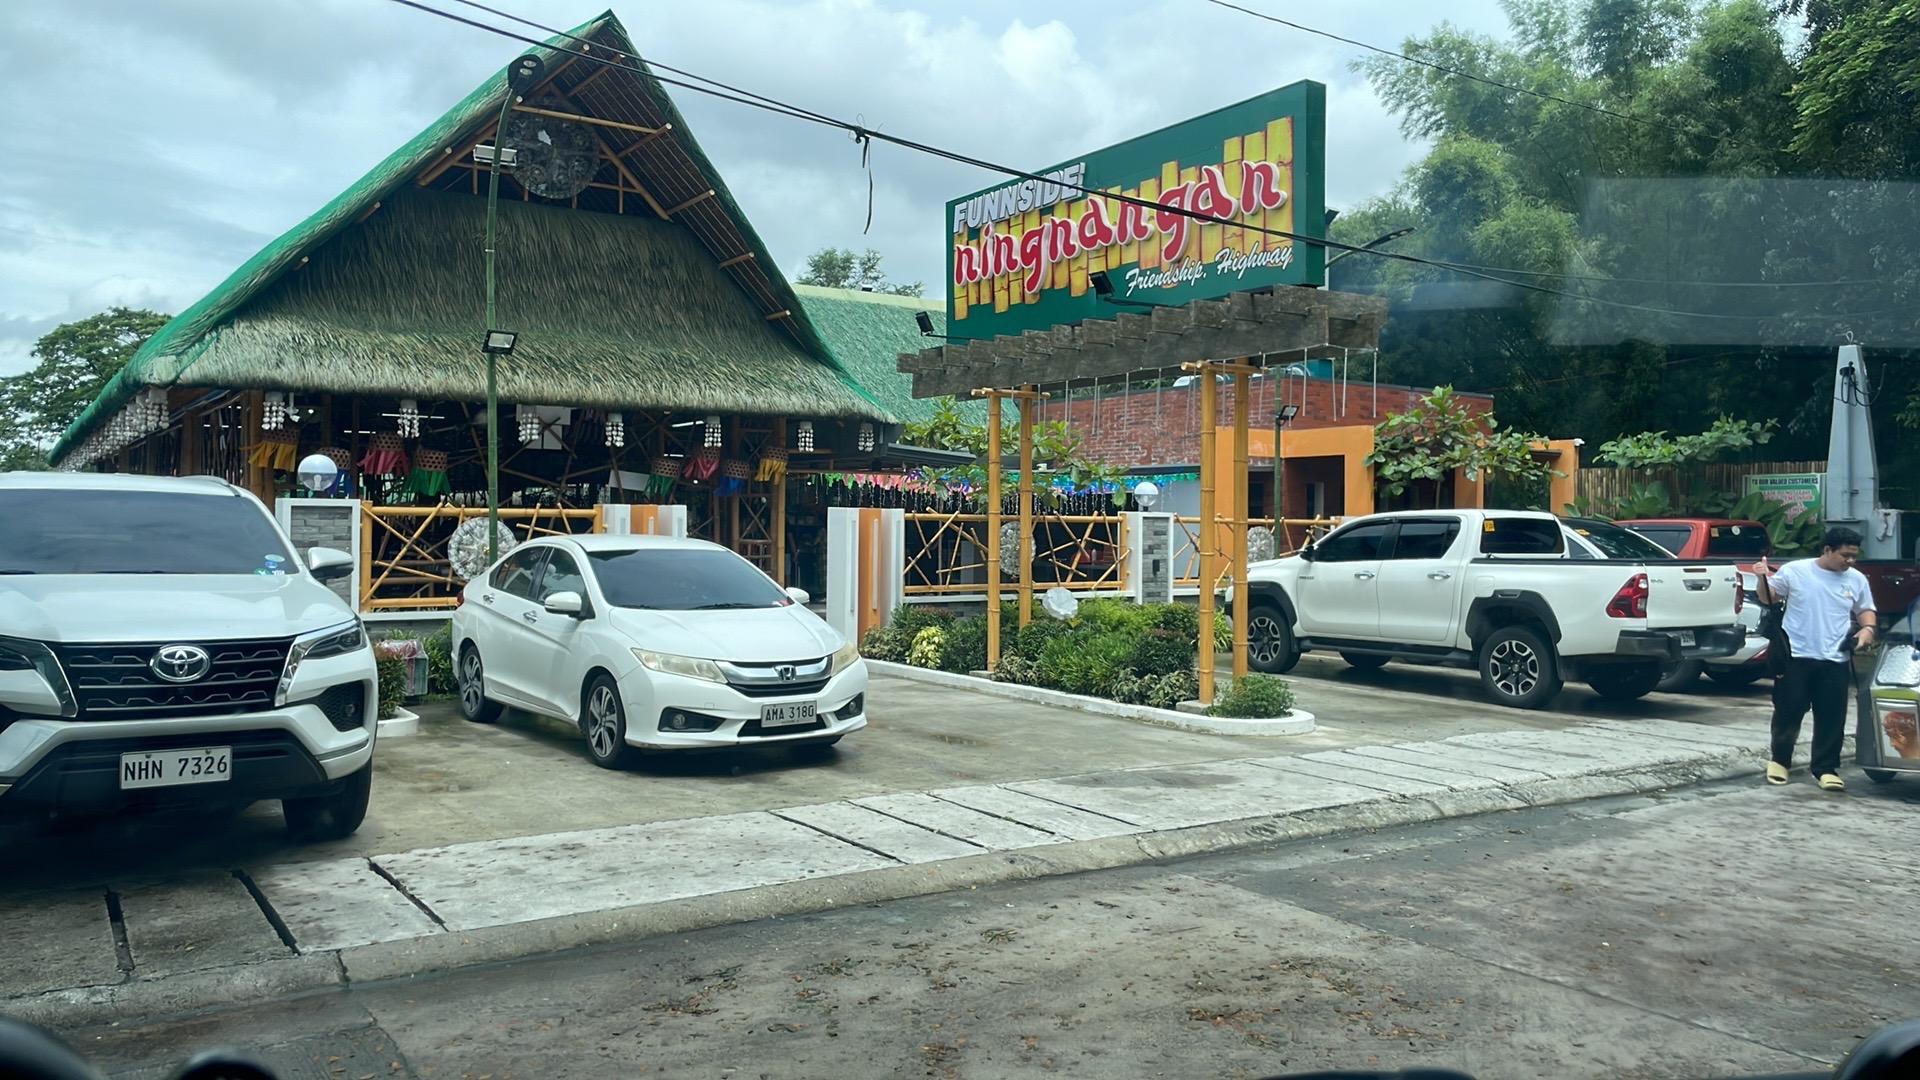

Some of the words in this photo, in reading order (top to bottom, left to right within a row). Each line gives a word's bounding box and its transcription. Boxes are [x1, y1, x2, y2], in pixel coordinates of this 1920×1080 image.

[953, 162, 1085, 234] FUNNSIDE
[1215, 241, 1293, 280] Highway
[1788, 477, 1819, 485] CUSTOMERS
[766, 707, 785, 721] AMA
[789, 704, 815, 719] 3180
[124, 760, 163, 781] NHN
[177, 755, 228, 777] 7326
